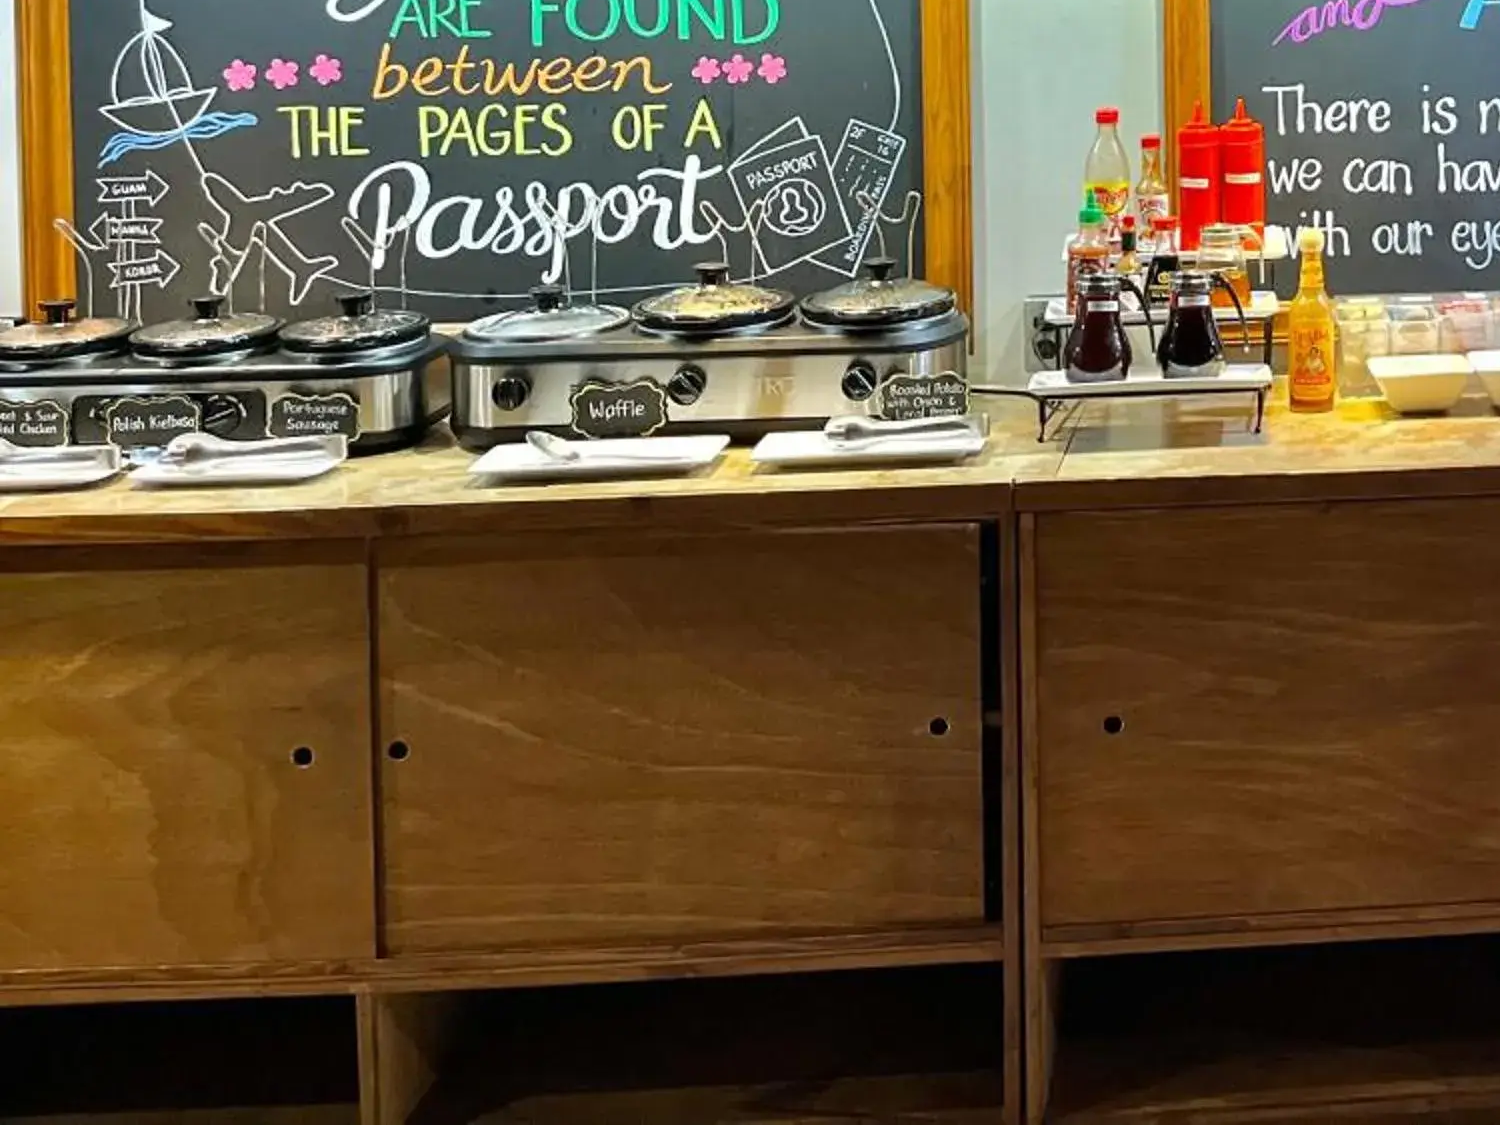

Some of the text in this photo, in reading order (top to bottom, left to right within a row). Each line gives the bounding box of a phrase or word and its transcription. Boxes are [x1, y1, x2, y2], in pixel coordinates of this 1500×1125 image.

[370, 43, 673, 101] between
[276, 99, 723, 159] THE PAGES OF A
[1261, 83, 1392, 136] There
[1420, 84, 1458, 135] is
[745, 151, 817, 190] PASSPORT
[1266, 157, 1323, 194] we
[1342, 158, 1414, 197] can
[347, 154, 724, 285] Passport
[1371, 217, 1434, 255] our
[19, 422, 58, 435] Chicken
[113, 415, 145, 432] Polish
[588, 398, 646, 421] Waffle
